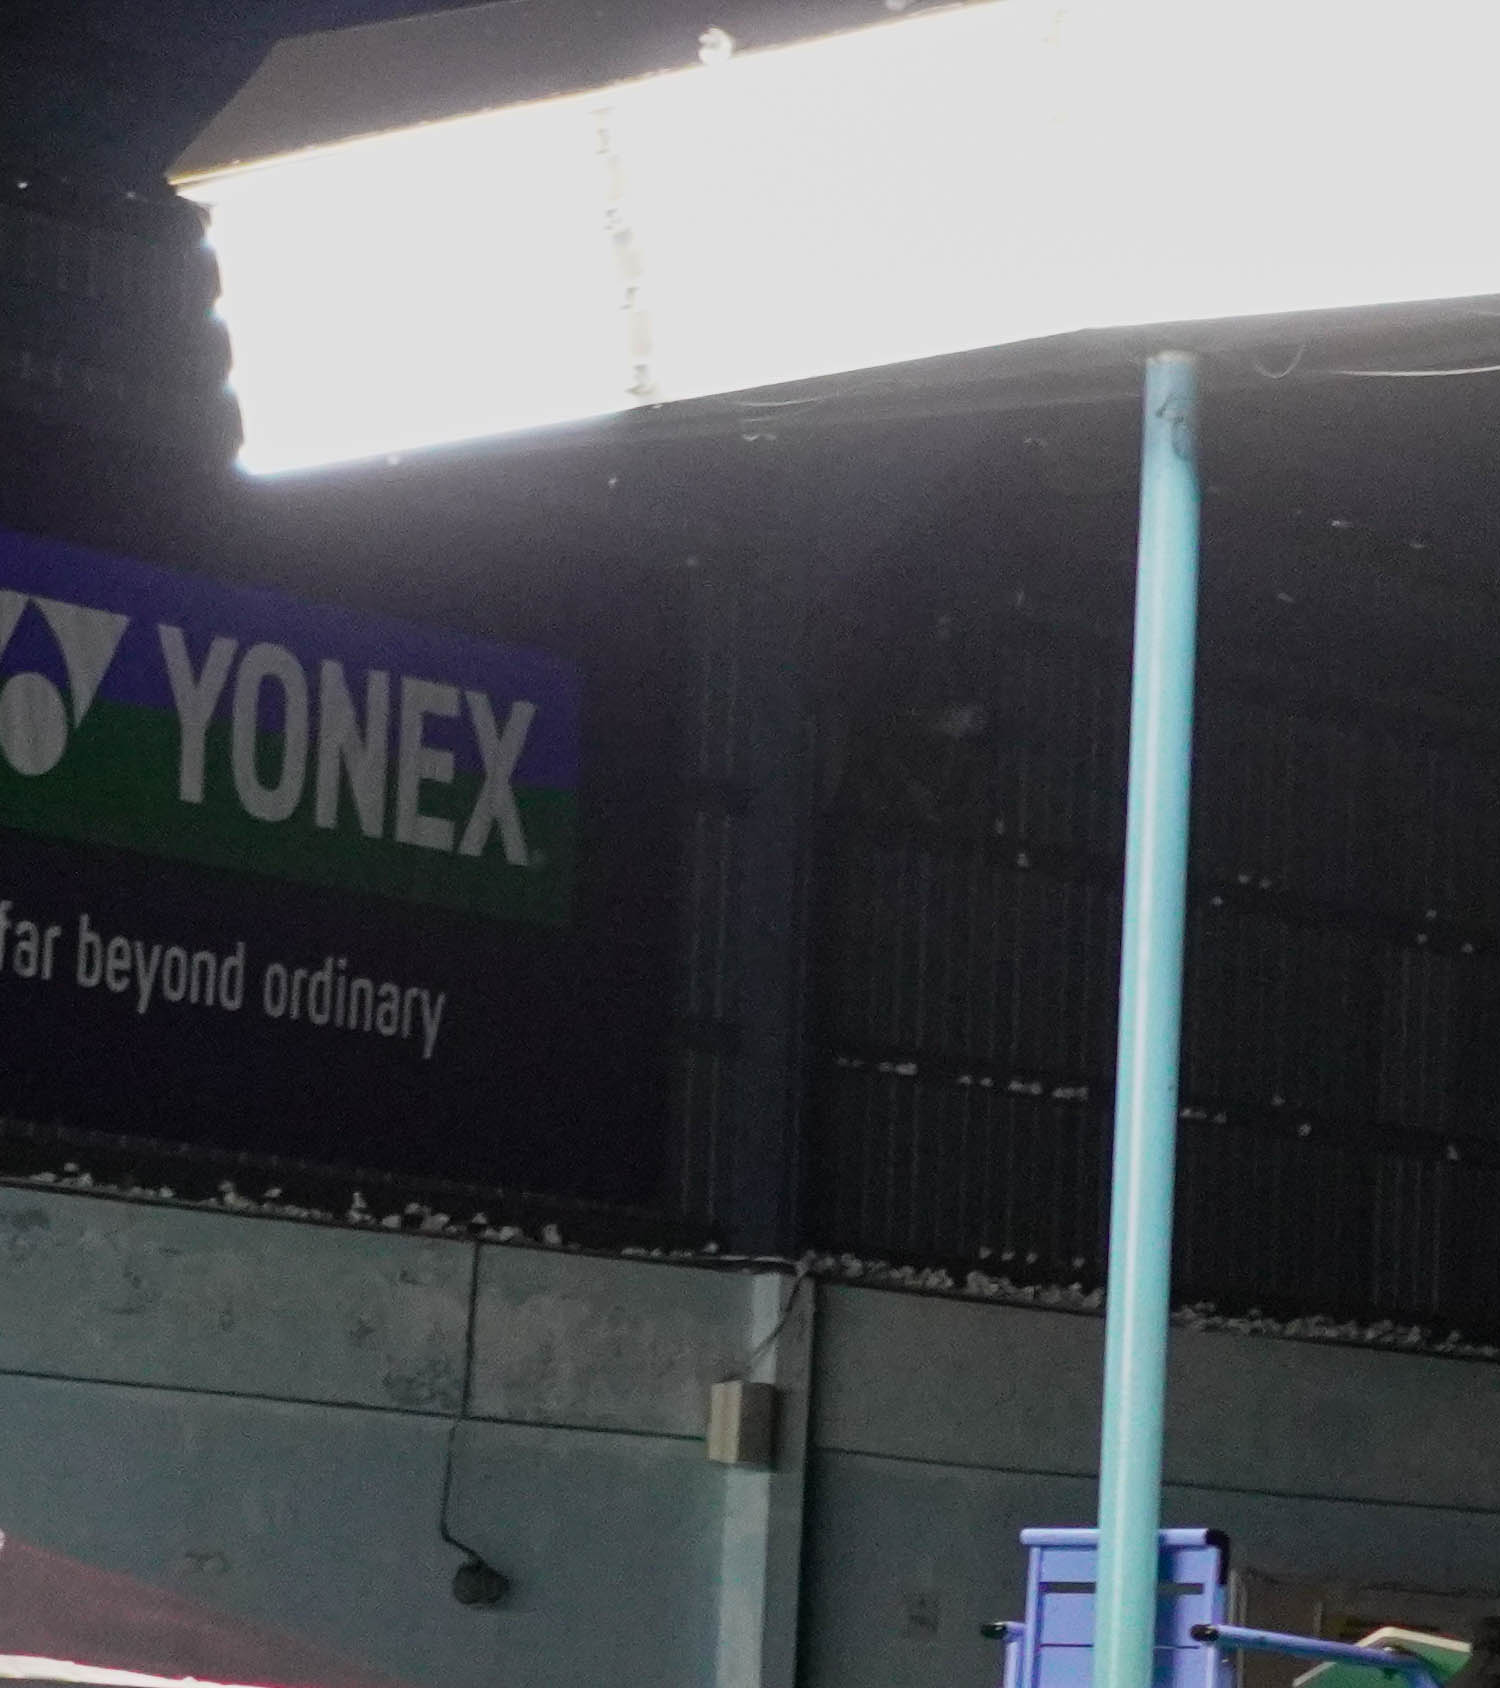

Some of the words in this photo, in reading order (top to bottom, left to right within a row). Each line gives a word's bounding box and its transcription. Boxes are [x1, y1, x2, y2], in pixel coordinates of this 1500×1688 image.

[157, 622, 538, 867] YONEX
[77, 912, 246, 1014] beyond
[263, 953, 448, 1060] ordinary
